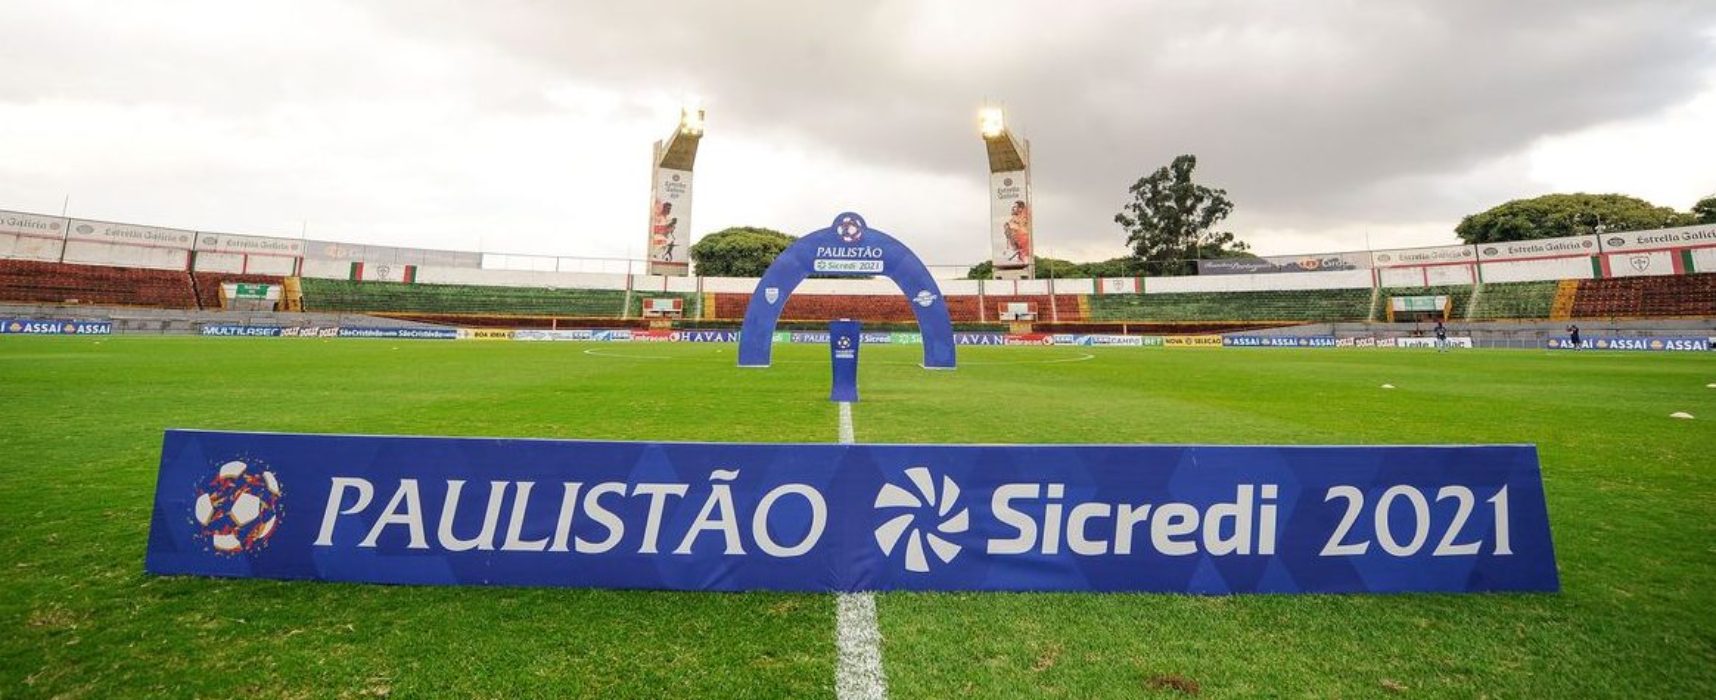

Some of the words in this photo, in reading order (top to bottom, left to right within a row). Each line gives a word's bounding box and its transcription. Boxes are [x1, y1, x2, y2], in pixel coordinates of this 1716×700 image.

[1637, 233, 1680, 244] Estrella
[1681, 230, 1716, 241] Galici
[816, 245, 883, 258] PAULISTÃO
[1508, 244, 1544, 254] Estrella
[1545, 242, 1580, 251] Galicia
[828, 261, 856, 270] Sicredi
[859, 261, 880, 271] 2021
[23, 322, 61, 333] ASSAÍ
[682, 331, 737, 342] HAVAN
[803, 332, 830, 343] PAULI
[1560, 339, 1593, 349] ASAÍ
[1609, 338, 1648, 350] ASSAÍ
[1665, 339, 1708, 350] ASSAÍ
[313, 468, 828, 558] PAULISTÃO
[986, 484, 1279, 556] Sicredi
[1318, 484, 1514, 557] 2021
